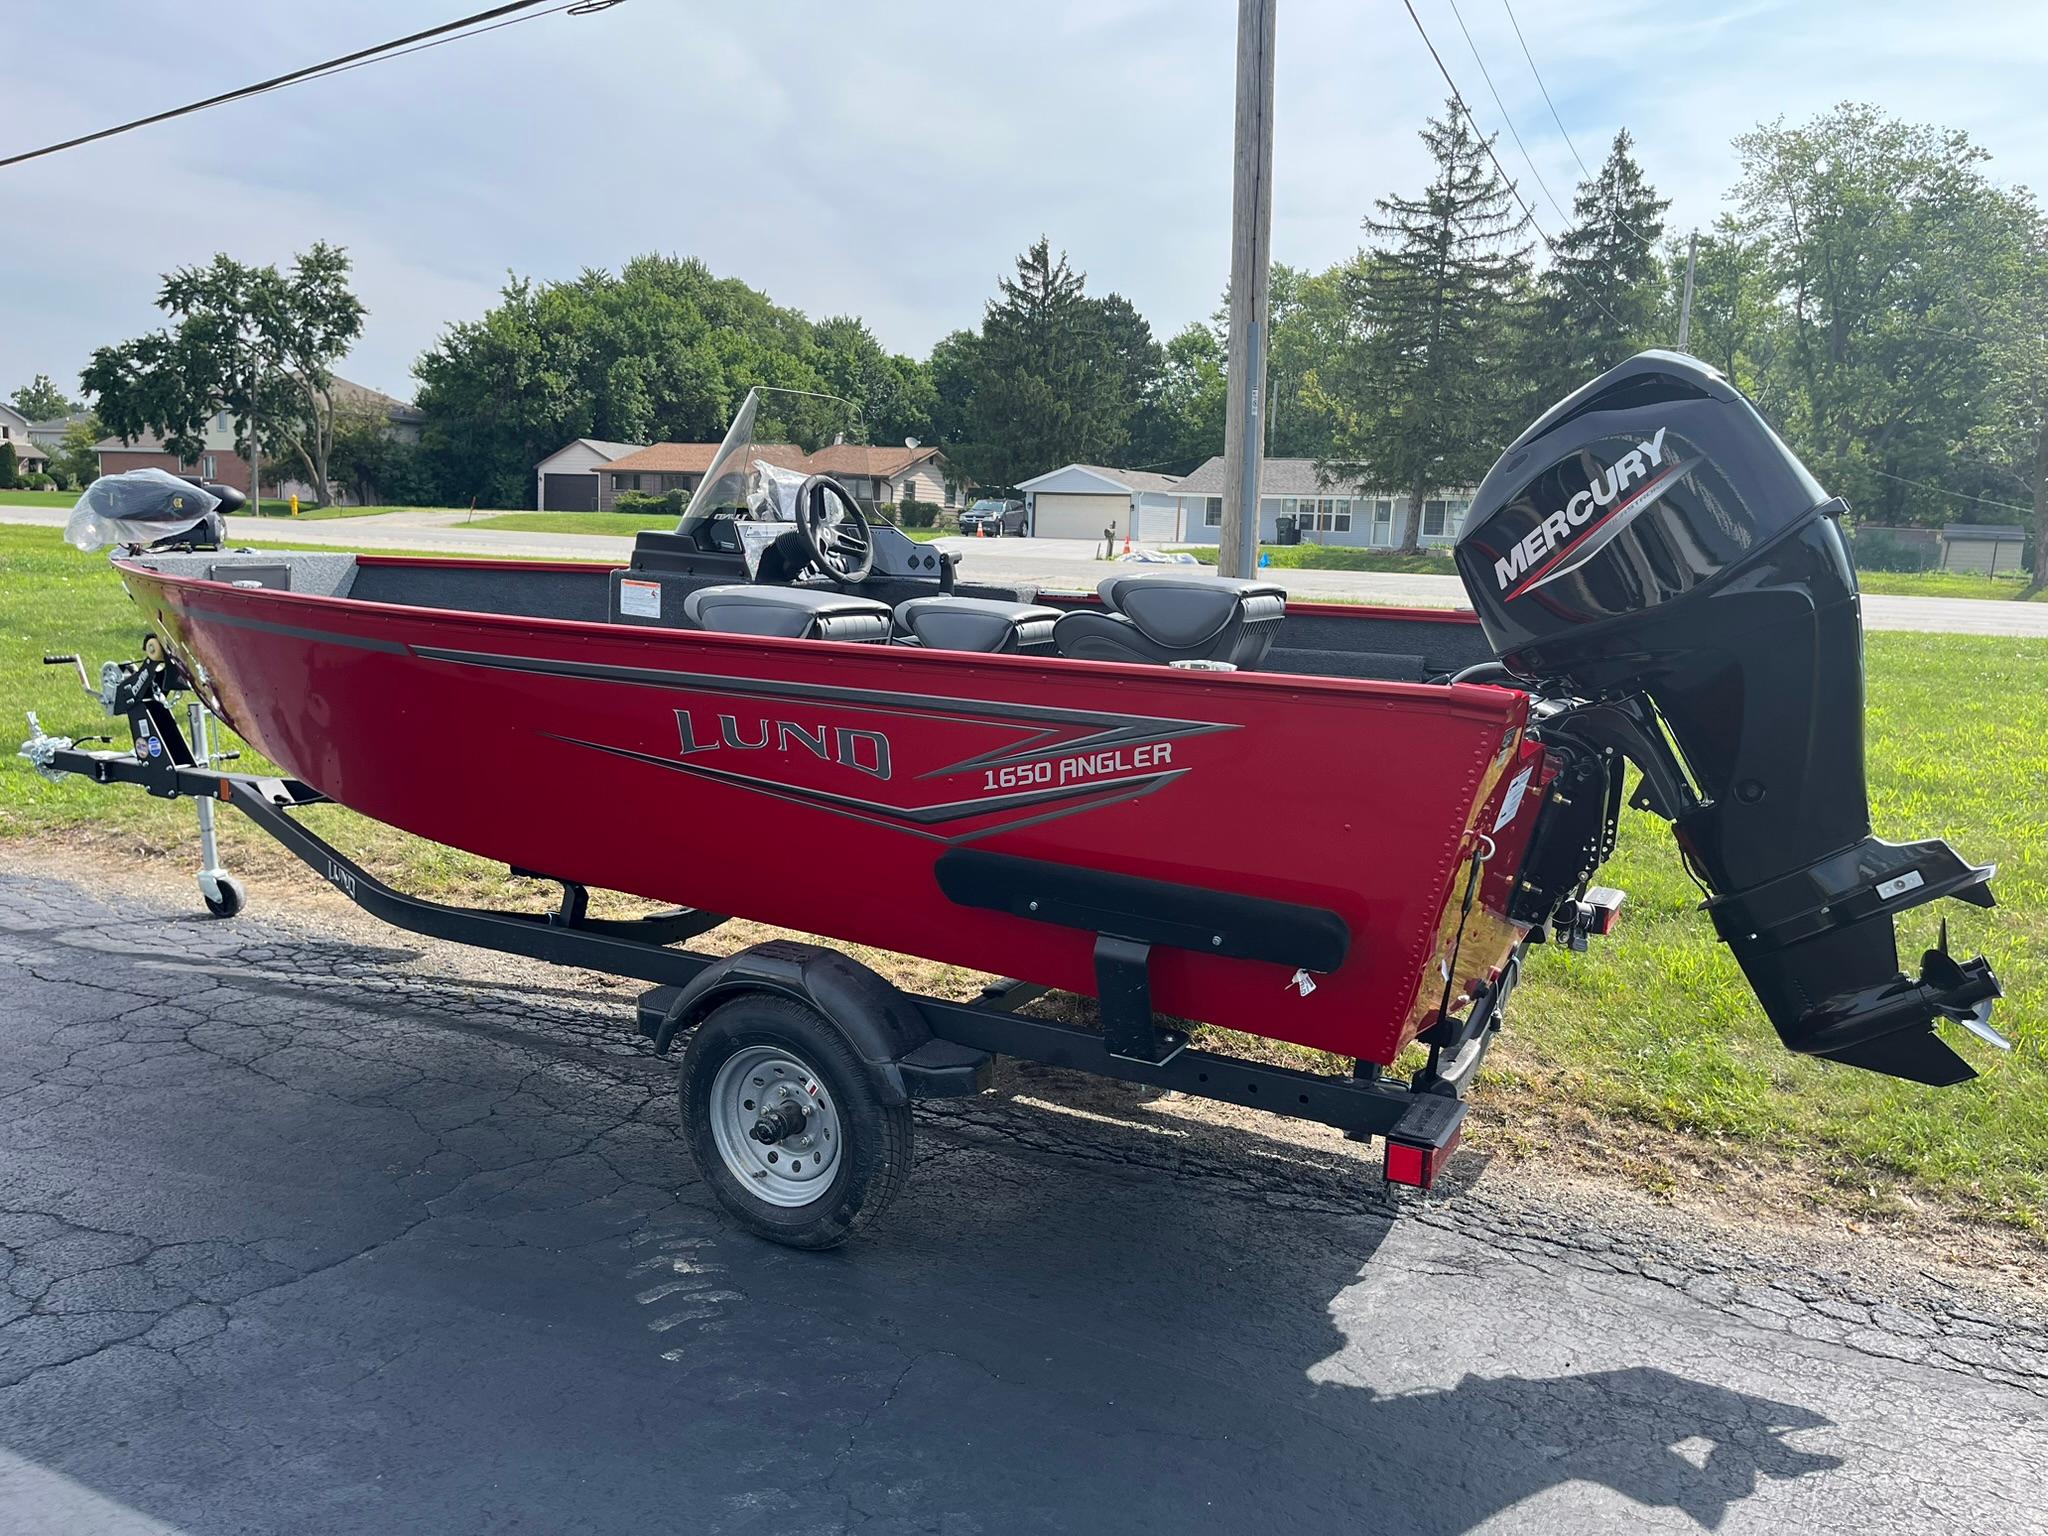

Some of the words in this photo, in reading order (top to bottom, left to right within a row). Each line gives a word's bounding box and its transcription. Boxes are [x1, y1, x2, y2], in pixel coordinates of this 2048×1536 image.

[1494, 426, 1666, 590] MERCURY
[673, 708, 892, 781] LUND
[983, 761, 1052, 791] 1650
[1059, 742, 1173, 786] ANGLER
[328, 860, 355, 899] LUND
